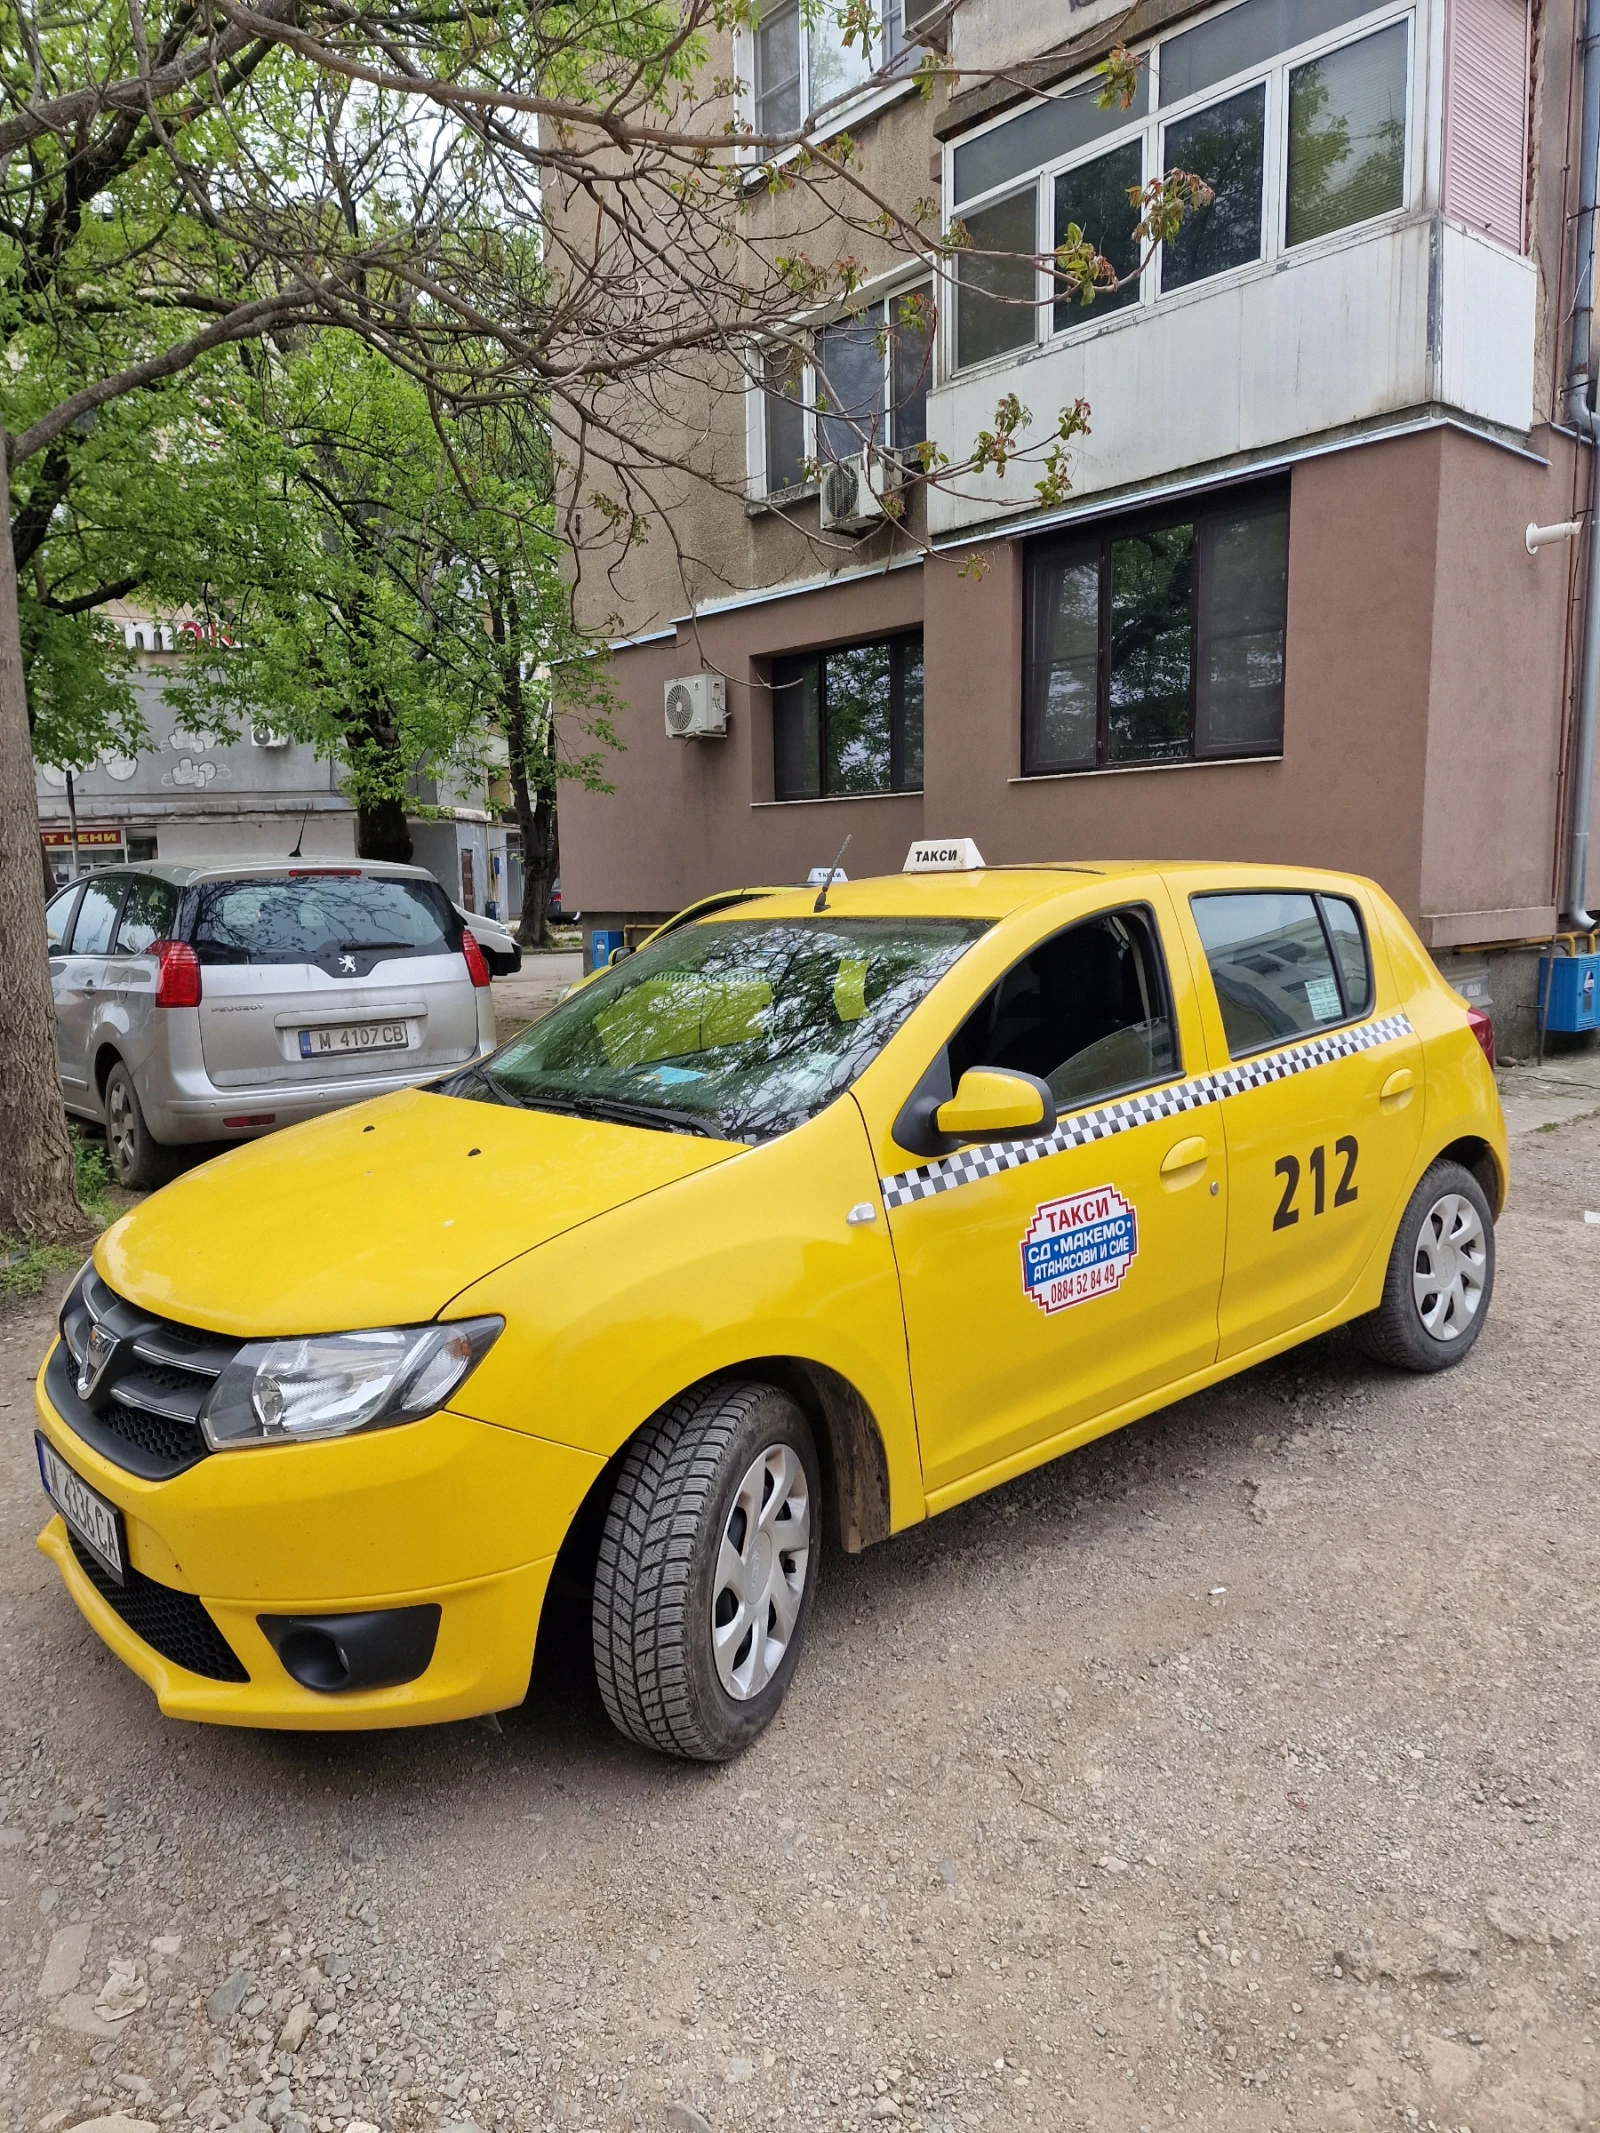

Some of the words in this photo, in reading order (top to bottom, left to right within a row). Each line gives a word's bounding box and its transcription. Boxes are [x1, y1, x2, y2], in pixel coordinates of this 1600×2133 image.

[915, 849, 957, 862] ТАКСИ
[211, 1003, 265, 1013] PEUGEOT
[319, 1033, 331, 1050] M
[340, 1028, 378, 1047] 4107
[1273, 1135, 1359, 1232] 212
[1046, 1196, 1109, 1233] ТАКСИ
[1028, 1242, 1051, 1264] СД
[1034, 1246, 1098, 1282] АТАНАСОВИ
[1100, 1243, 1108, 1259] И
[1109, 1236, 1130, 1255] СИЕ
[1051, 1277, 1074, 1304] 0884
[1077, 1273, 1088, 1296] 52
[1090, 1268, 1101, 1290] 84
[1104, 1263, 1115, 1285] 49
[64, 1471, 95, 1539] 4336
